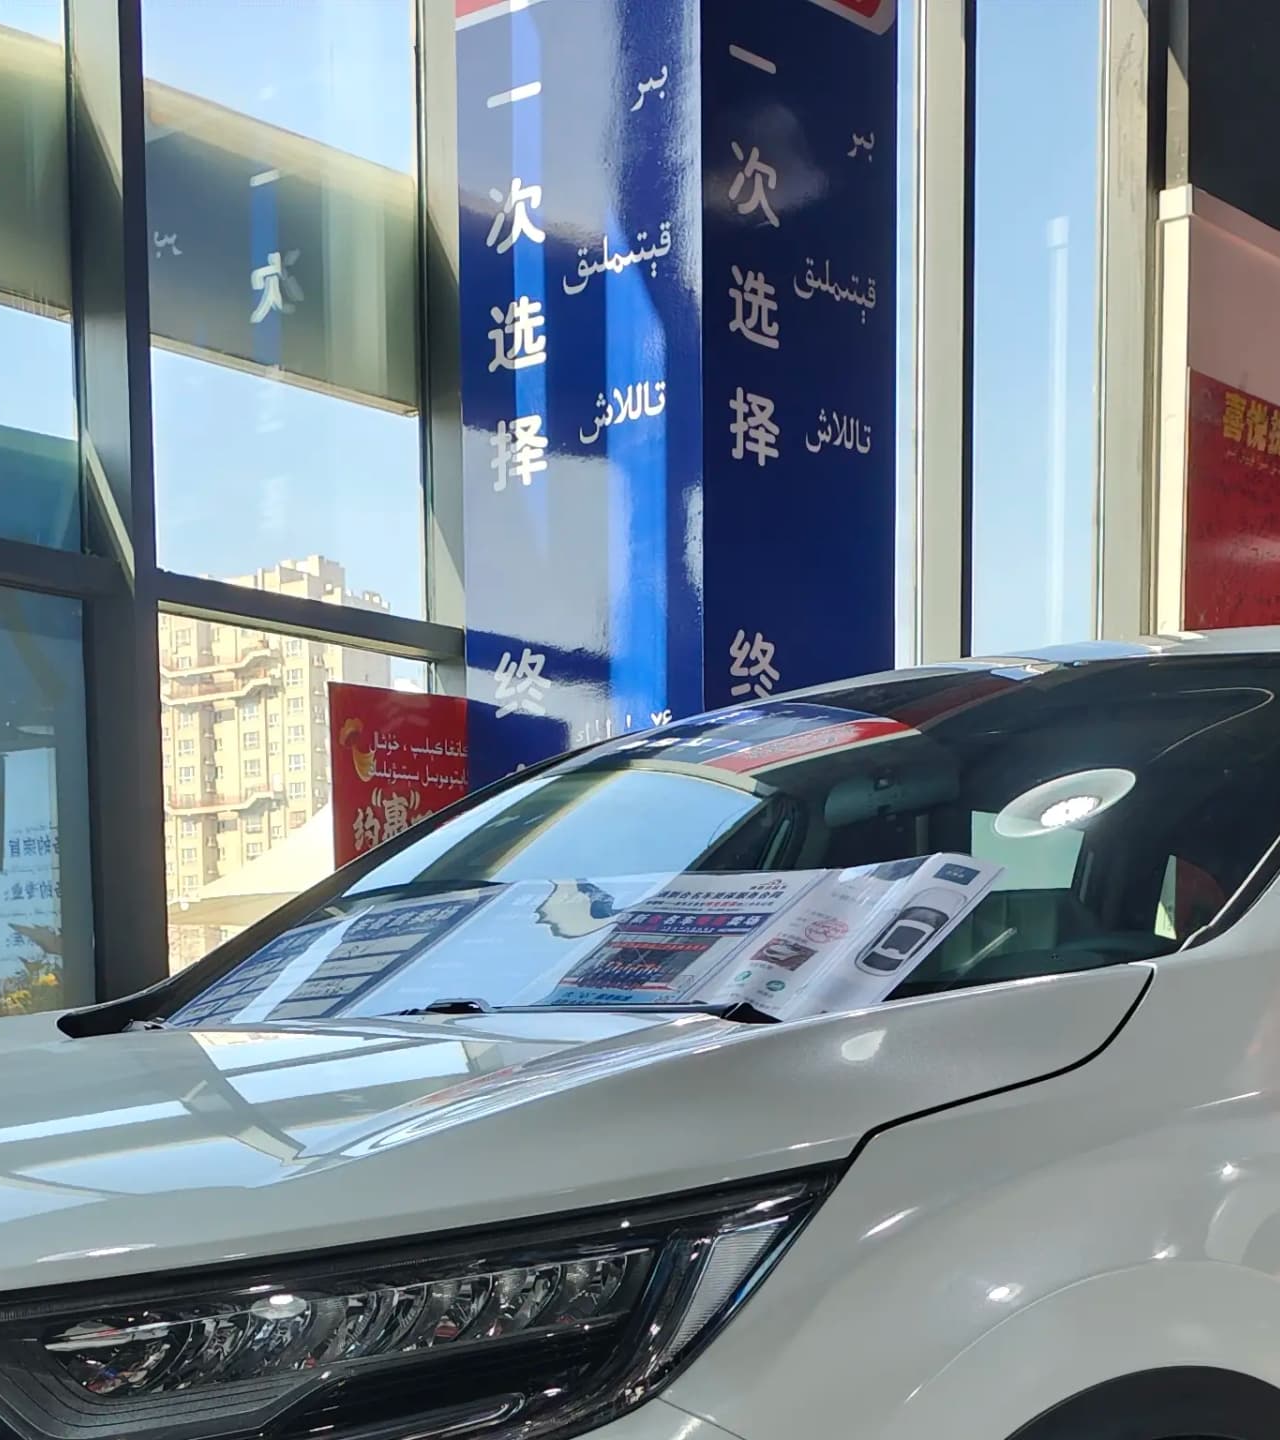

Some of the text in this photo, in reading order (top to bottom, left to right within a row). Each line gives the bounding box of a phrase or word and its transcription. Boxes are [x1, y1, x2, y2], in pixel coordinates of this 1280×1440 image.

[487, 81, 548, 493] 一次选择
[729, 44, 781, 468] 一次选择
